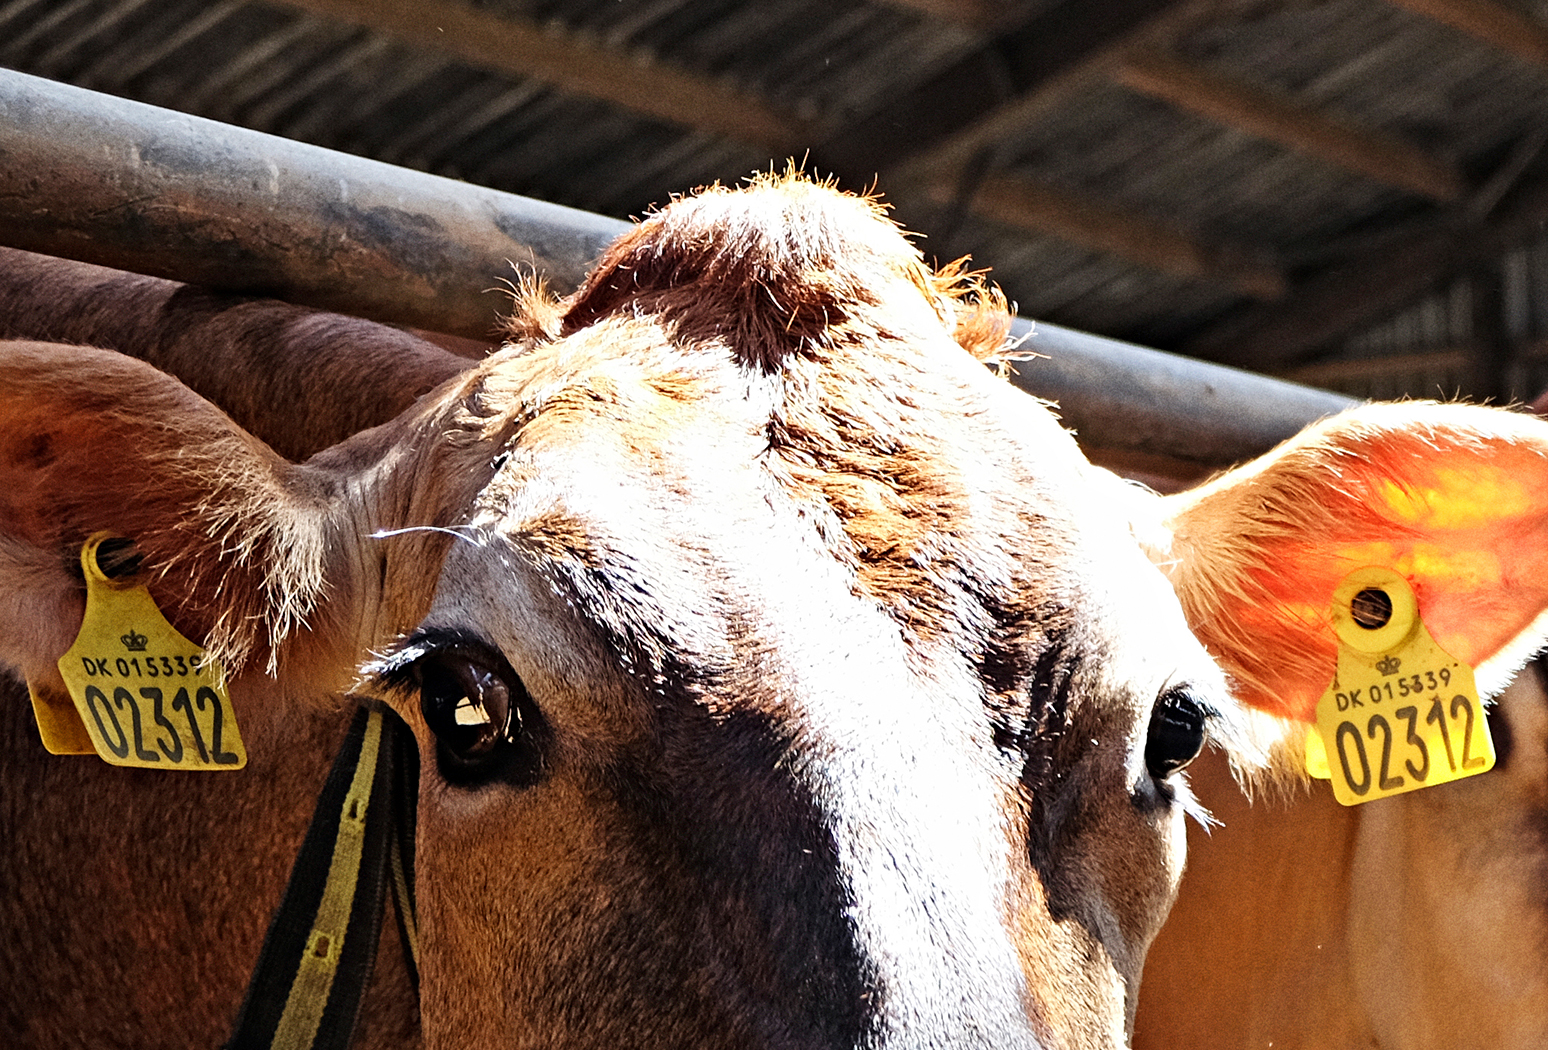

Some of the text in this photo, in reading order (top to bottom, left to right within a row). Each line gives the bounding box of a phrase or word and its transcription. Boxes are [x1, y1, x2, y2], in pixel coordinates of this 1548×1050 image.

[81, 655, 202, 678] DK 015339
[1335, 667, 1451, 712] DK 015339
[84, 684, 239, 765] 02312
[1335, 694, 1486, 796] 02312
